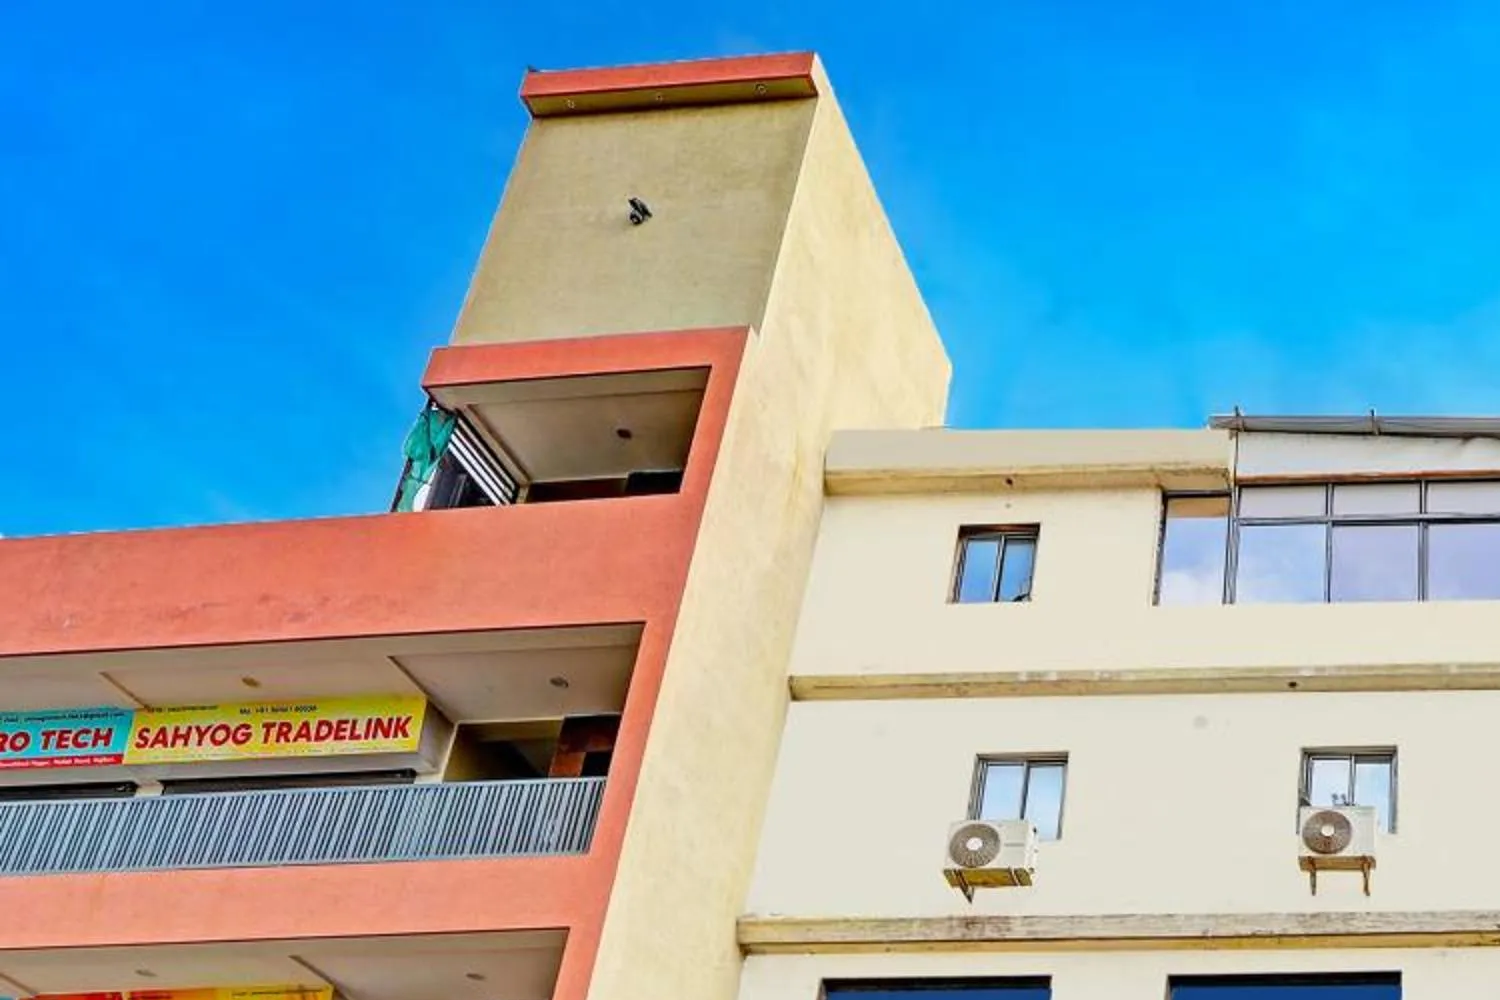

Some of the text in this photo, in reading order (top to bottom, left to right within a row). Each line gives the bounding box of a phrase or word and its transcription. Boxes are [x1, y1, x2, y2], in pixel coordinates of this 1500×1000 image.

[41, 727, 113, 750] TECH
[135, 716, 412, 750] SAHYOG TRADELINK
